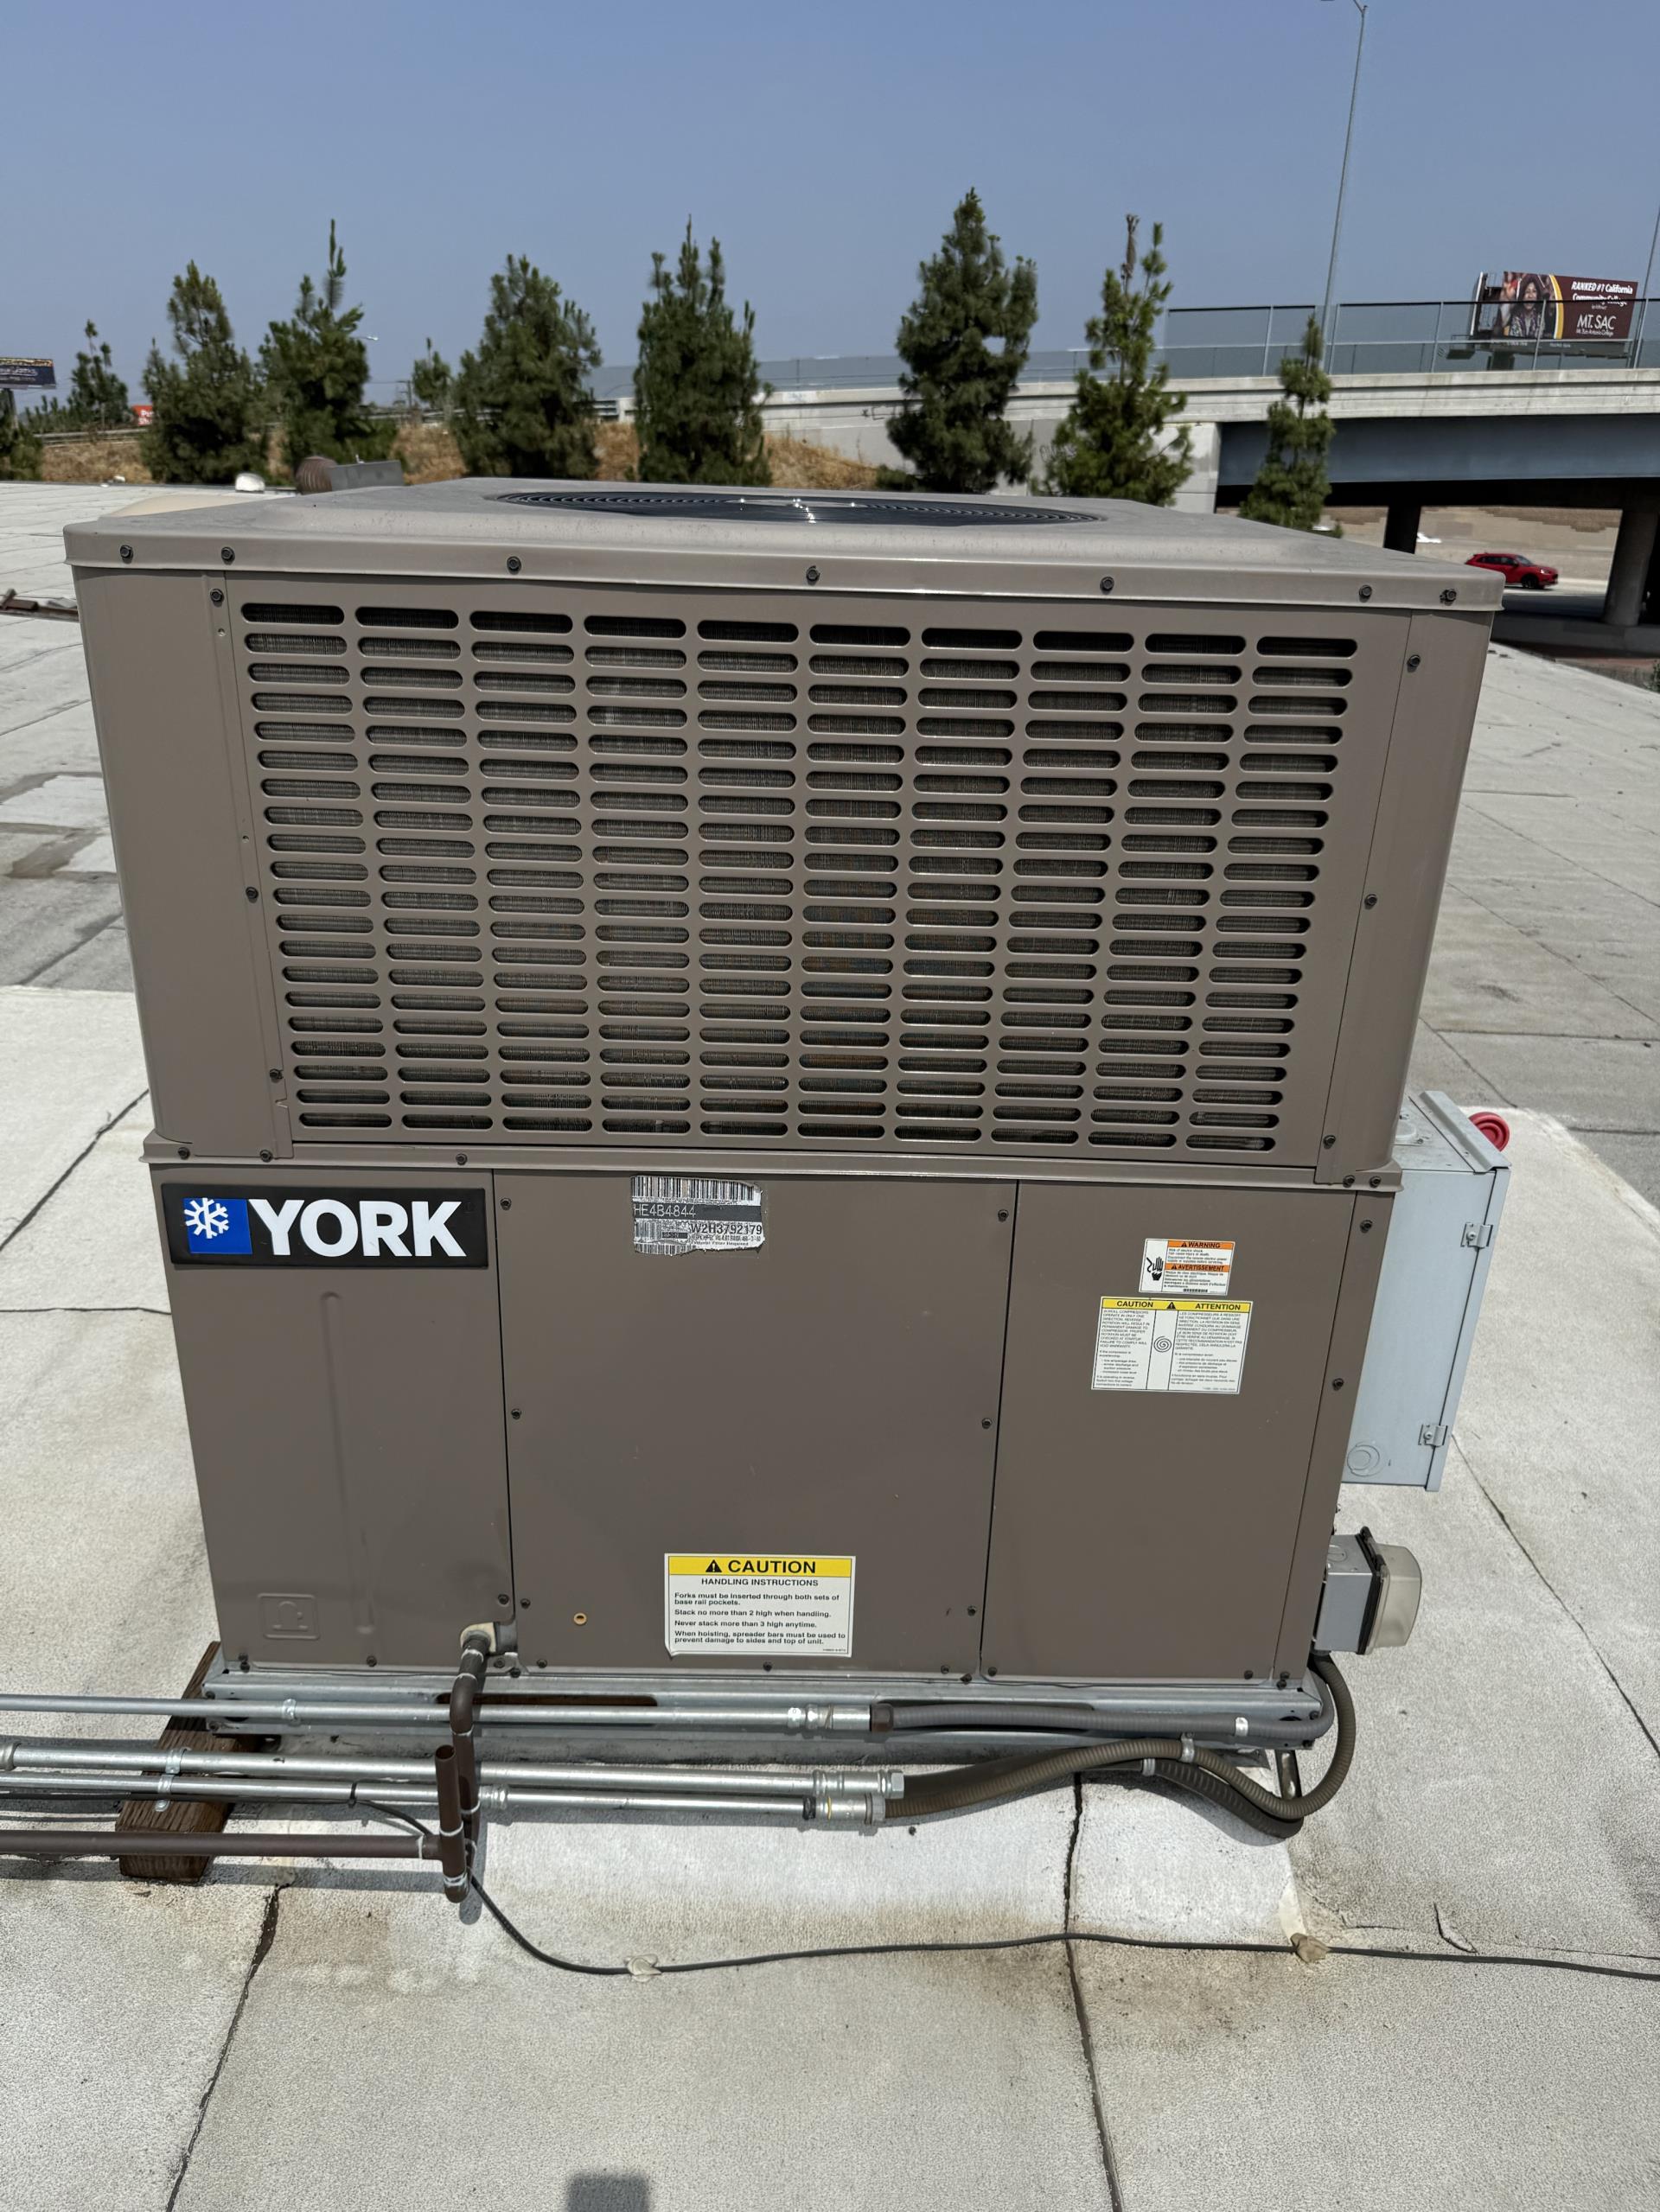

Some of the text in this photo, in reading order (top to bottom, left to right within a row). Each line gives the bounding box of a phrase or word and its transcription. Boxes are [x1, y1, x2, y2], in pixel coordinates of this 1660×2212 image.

[1571, 281, 1633, 294] RANKED #1 California
[1577, 314, 1616, 329] MT. SAC
[249, 1199, 467, 1257] YORK
[727, 1559, 816, 1573] CAUTION
